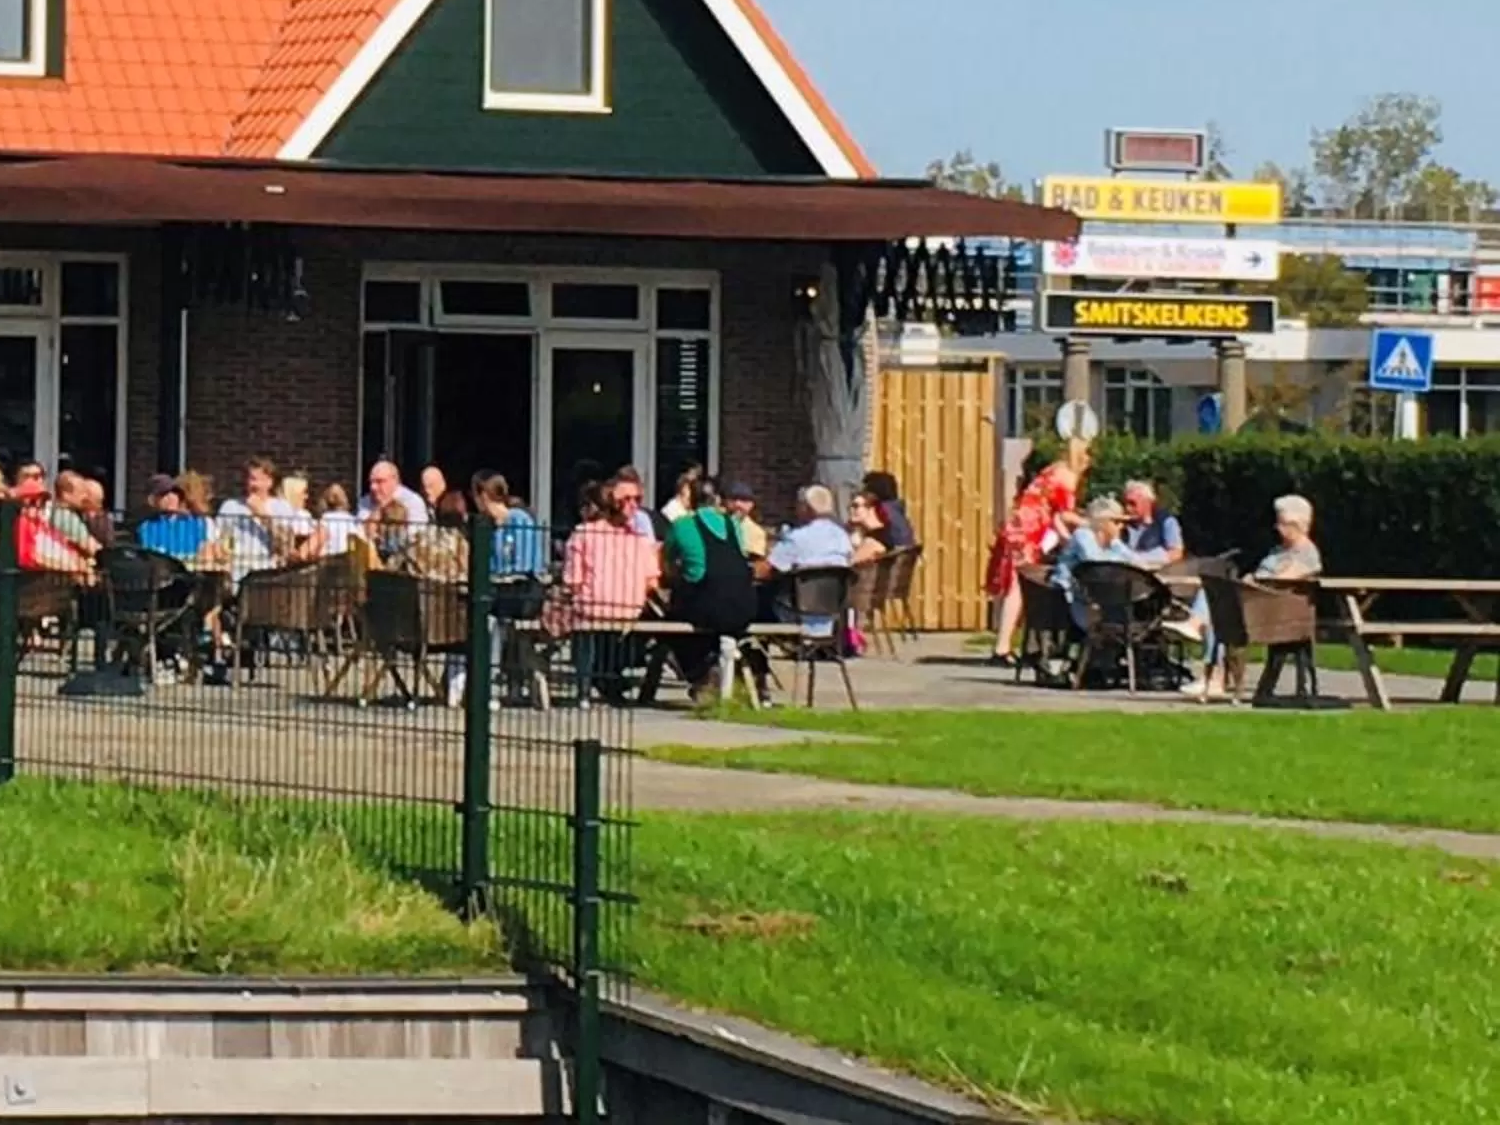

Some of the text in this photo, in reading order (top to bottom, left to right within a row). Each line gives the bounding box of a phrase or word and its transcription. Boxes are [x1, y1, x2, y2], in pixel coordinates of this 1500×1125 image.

[1051, 184, 1223, 214] BAD & KEUKEN
[1073, 301, 1249, 328] SMITSKEUKENS
